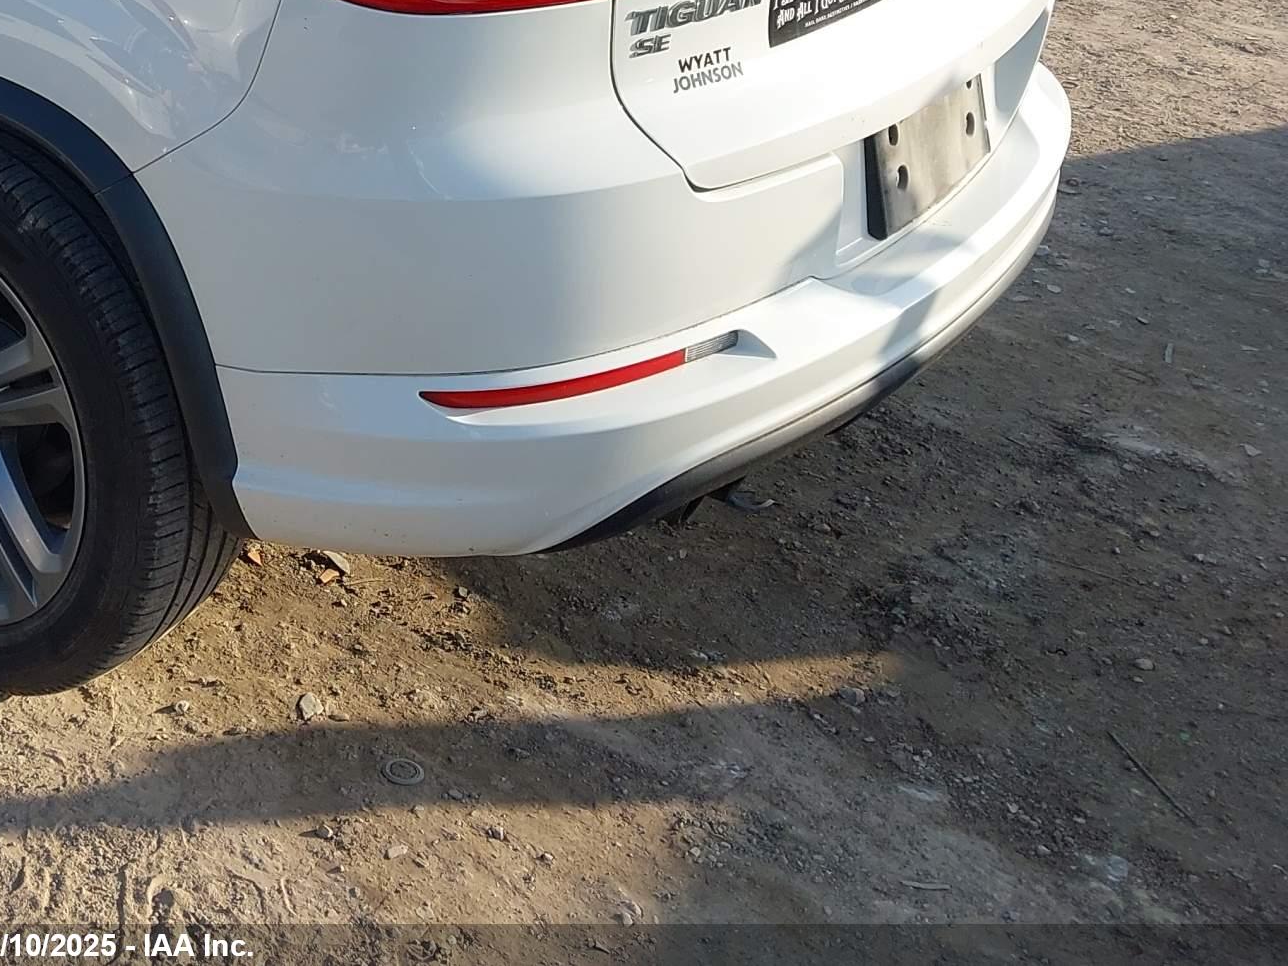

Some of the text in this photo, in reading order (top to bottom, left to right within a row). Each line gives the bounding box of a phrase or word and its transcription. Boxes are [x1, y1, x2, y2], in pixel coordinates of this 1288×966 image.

[629, 34, 672, 59] SE
[678, 46, 731, 74] WYATT
[673, 61, 744, 94] JOHNSON
